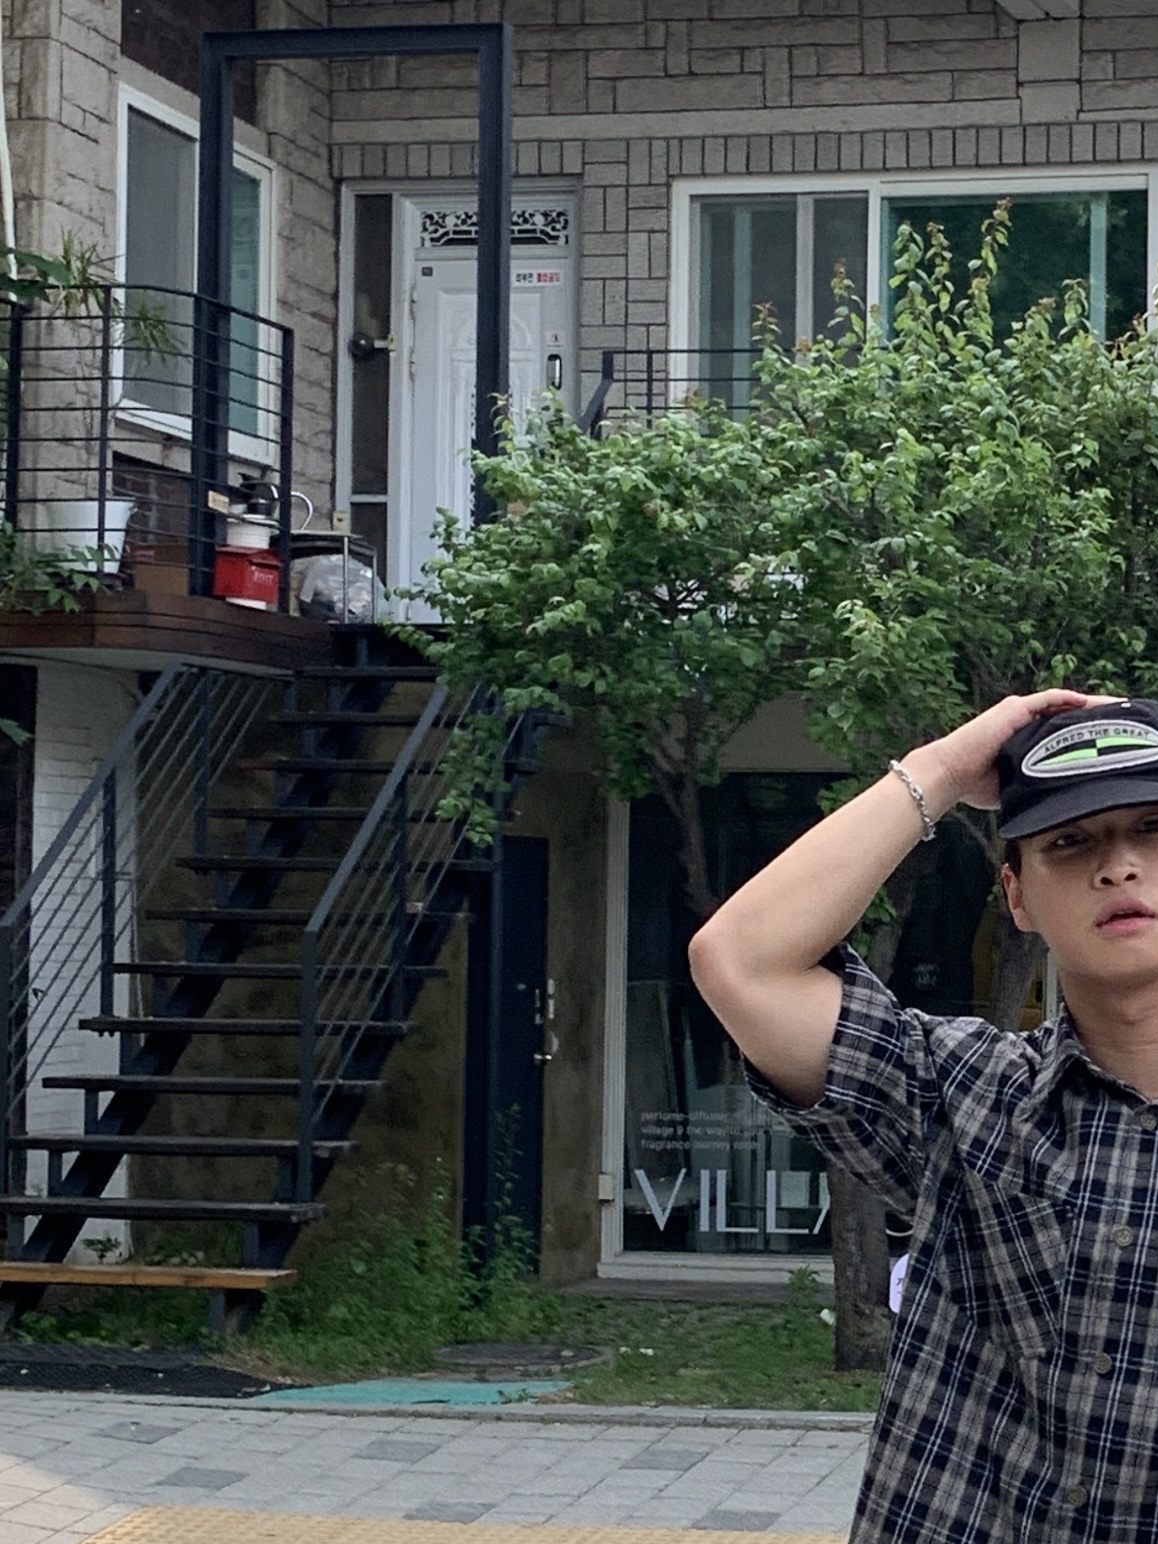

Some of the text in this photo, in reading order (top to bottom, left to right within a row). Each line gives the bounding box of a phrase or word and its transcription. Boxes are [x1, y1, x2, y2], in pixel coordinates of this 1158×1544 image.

[1044, 727, 1150, 755] ALFRED THE GREAT
